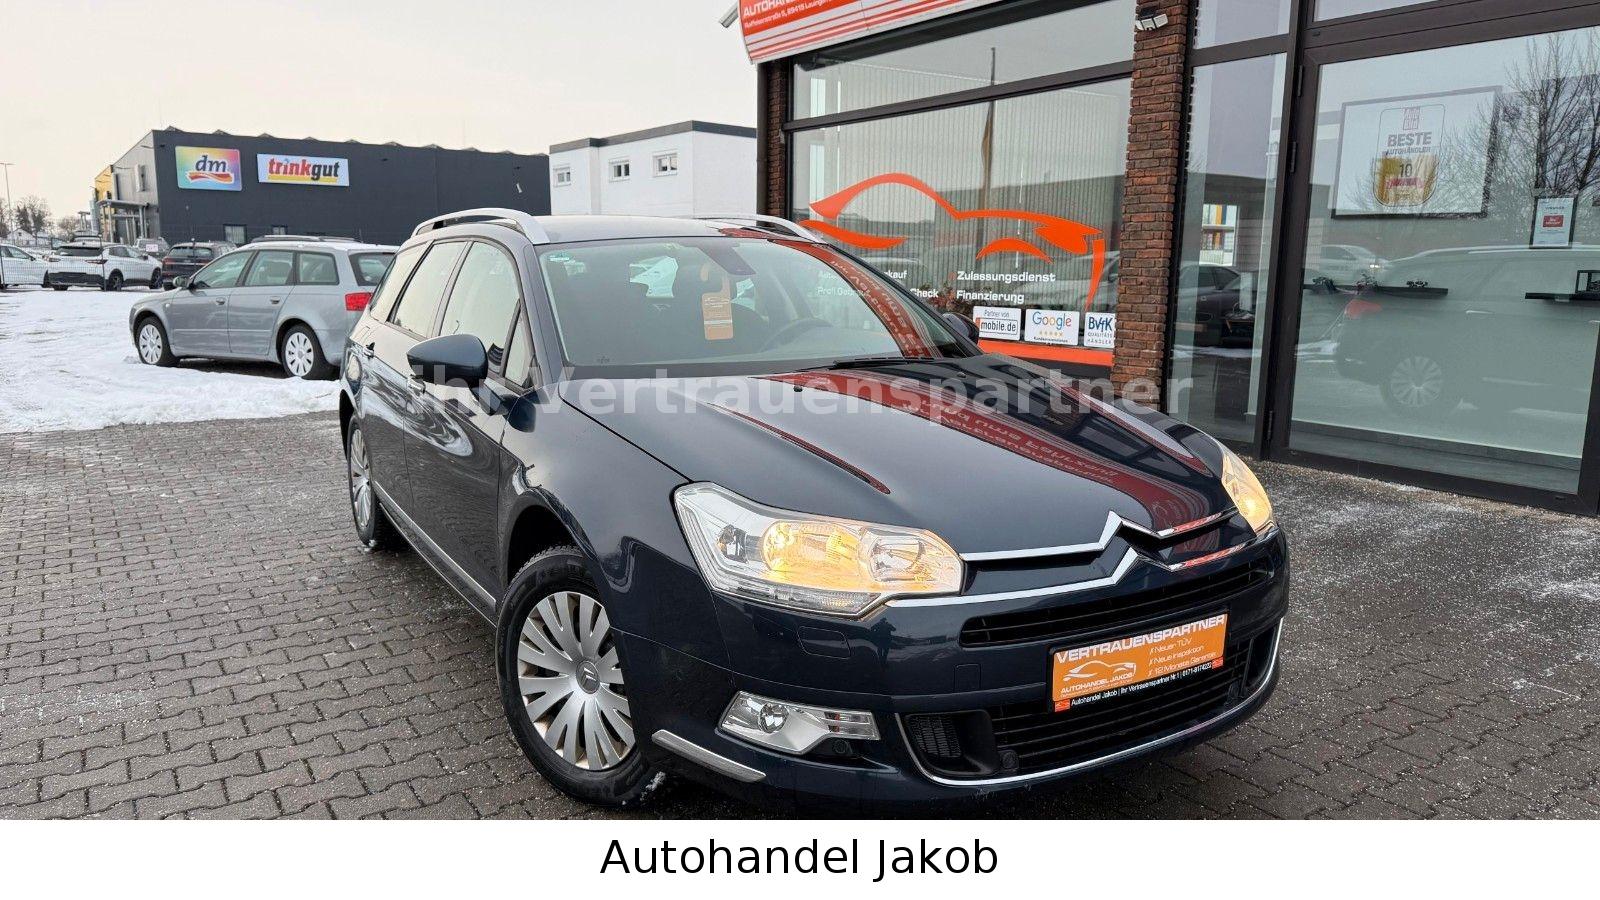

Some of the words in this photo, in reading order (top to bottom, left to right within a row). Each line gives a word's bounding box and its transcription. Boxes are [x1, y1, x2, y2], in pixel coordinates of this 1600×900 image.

[1387, 131, 1432, 147] BESTE
[195, 154, 227, 173] dm
[268, 158, 340, 181] trinkgut
[1400, 163, 1412, 177] 10
[956, 271, 1057, 284] Zulassungsdienst
[956, 289, 1025, 304] Finanzierung
[984, 309, 1000, 317] Partner
[1032, 311, 1072, 330] Google
[980, 321, 1017, 332] mobile.de
[1088, 316, 1113, 332] BvfK
[1056, 614, 1226, 664] VERTRAUENSPARTNER
[1177, 637, 1193, 648] TÜV
[1060, 678, 1111, 694] AUTOHANDEL
[1109, 671, 1134, 683] JAKOB
[1071, 693, 1101, 706] Autohandel
[1102, 690, 1118, 699] Jakob
[1120, 686, 1129, 695] Ihr
[1128, 675, 1170, 692] Vertrauenspartner
